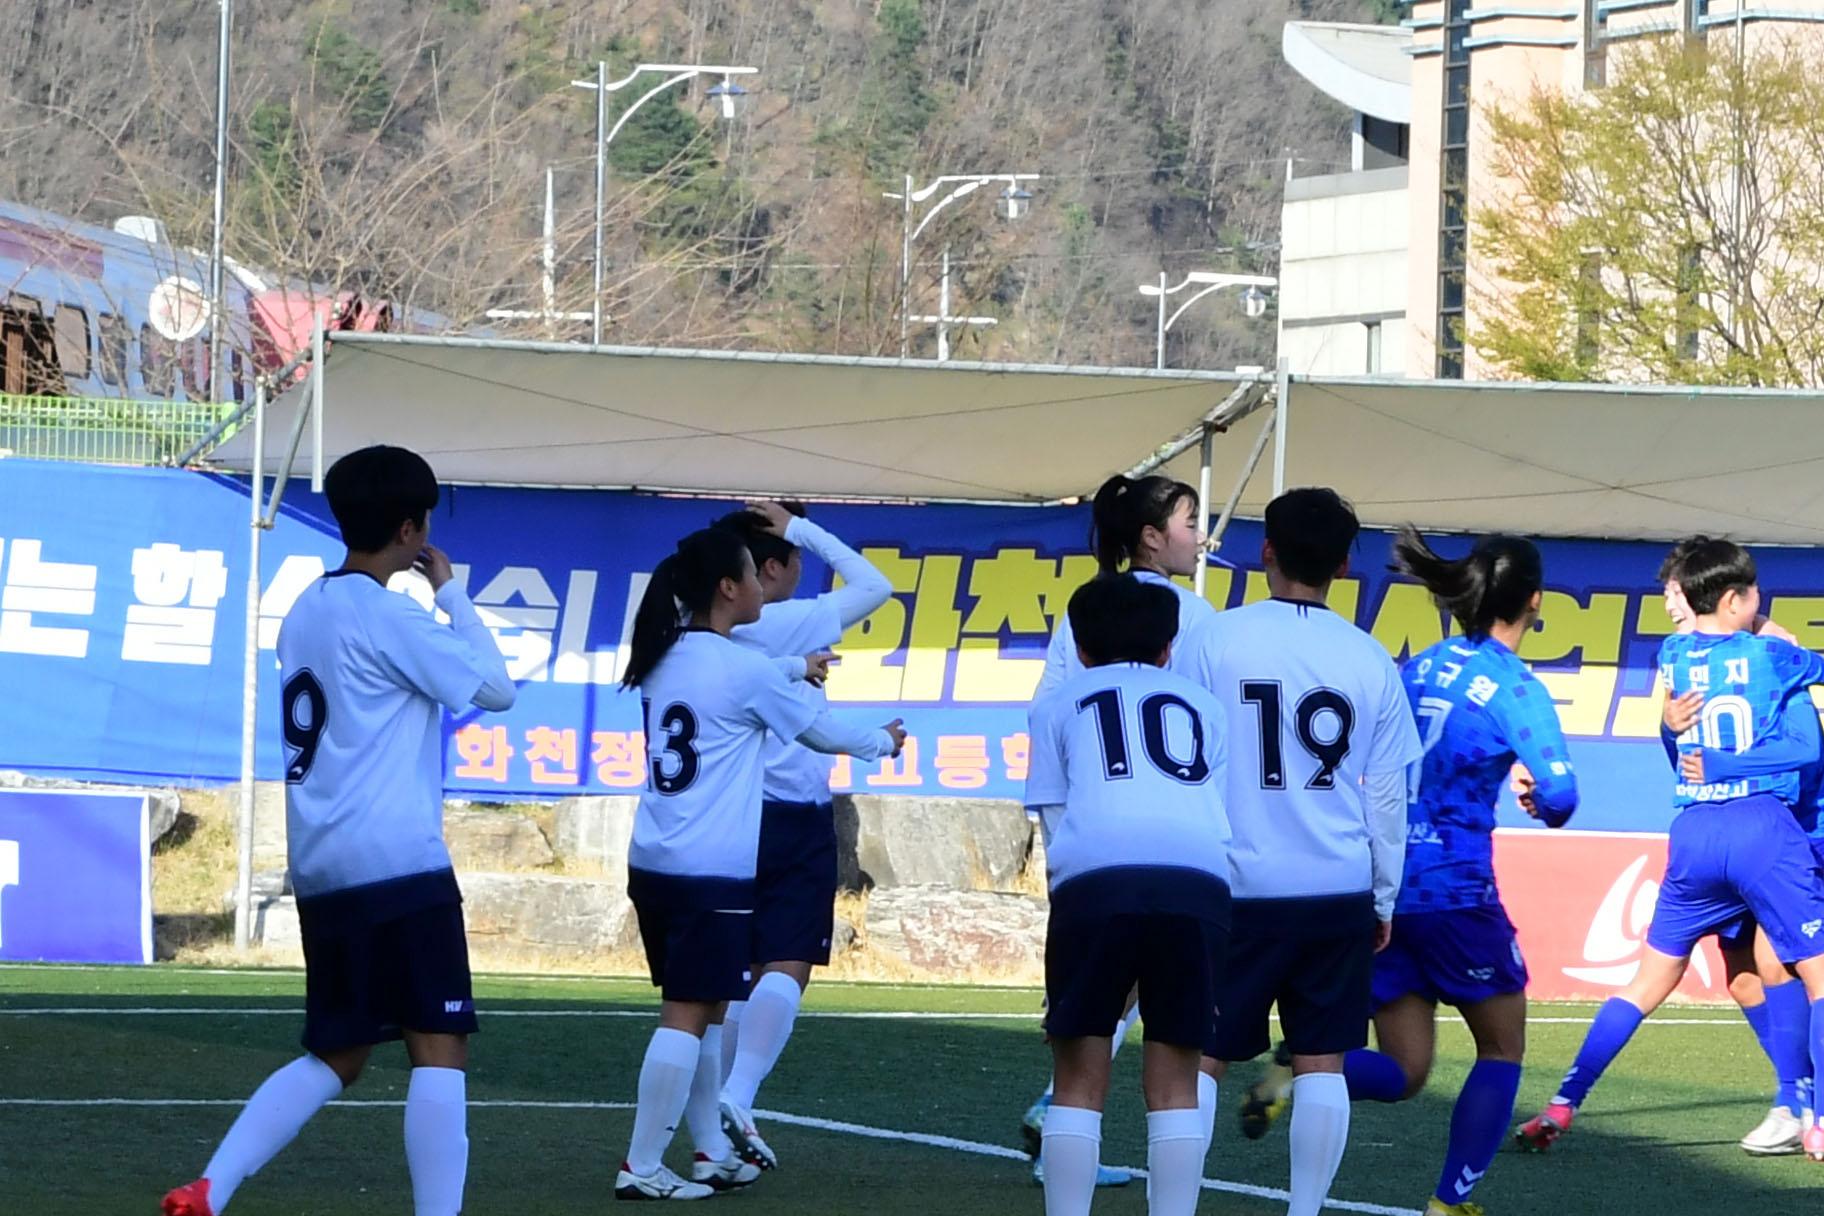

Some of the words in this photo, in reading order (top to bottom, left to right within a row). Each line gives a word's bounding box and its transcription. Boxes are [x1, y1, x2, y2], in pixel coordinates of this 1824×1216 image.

[0, 537, 97, 658] 는
[121, 542, 228, 666] 할
[282, 667, 329, 785] 9
[1076, 686, 1212, 785] 10
[1239, 679, 1356, 791] 19
[1676, 695, 1754, 756] 0
